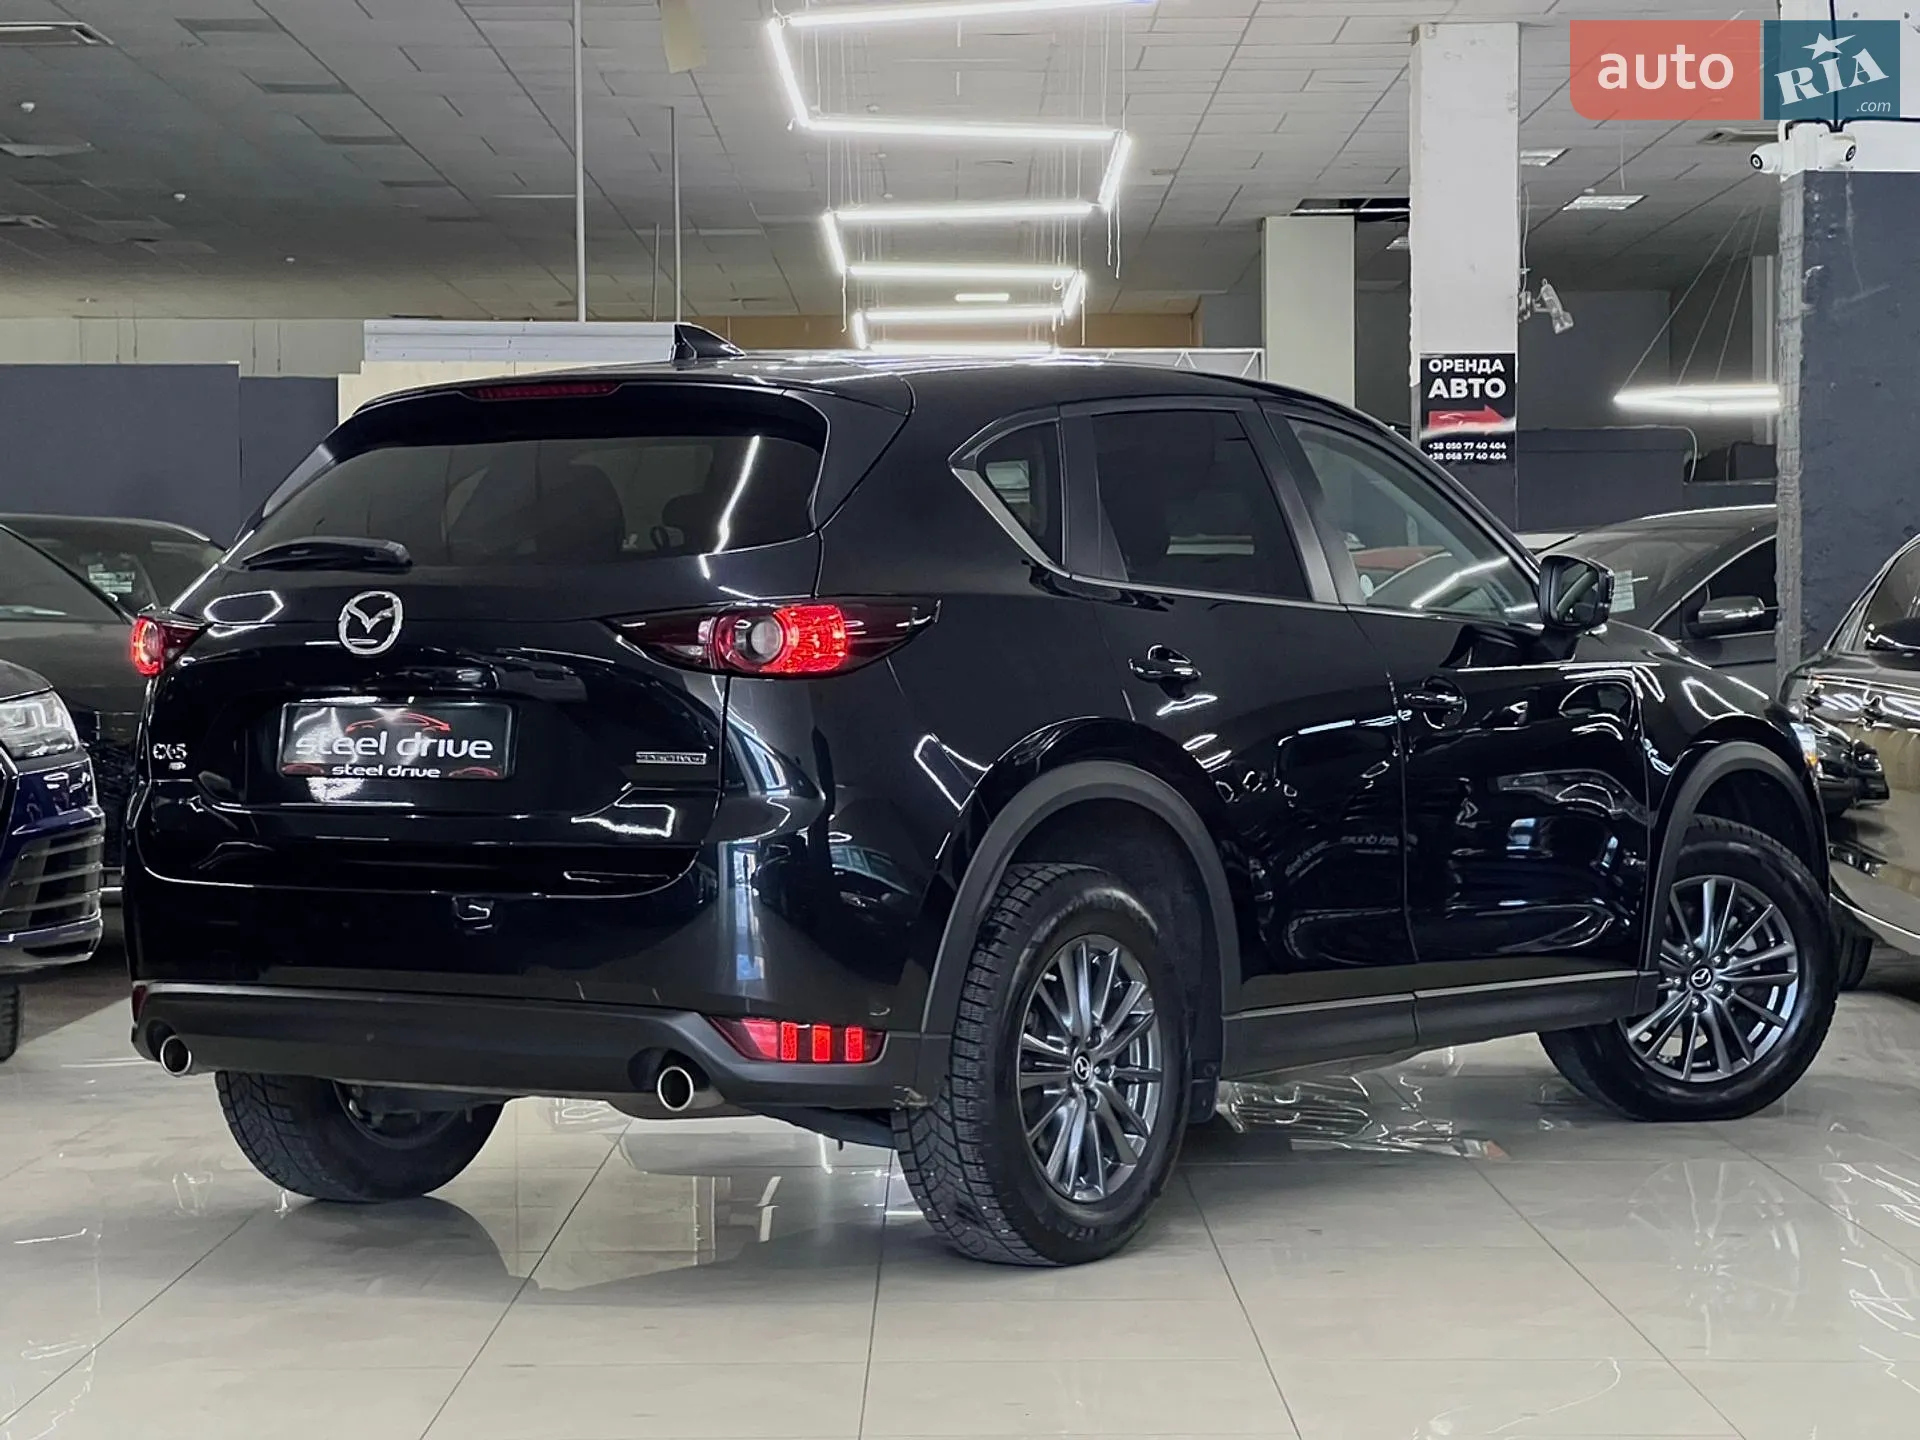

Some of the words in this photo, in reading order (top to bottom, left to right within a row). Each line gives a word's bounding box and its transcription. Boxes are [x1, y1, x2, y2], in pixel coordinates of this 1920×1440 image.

[1428, 358, 1506, 375] ОРЕНДА
[1427, 377, 1507, 399] АВТО
[1428, 442, 1444, 450] +38
[1463, 442, 1475, 450] 77
[1475, 442, 1488, 450] 40
[1489, 442, 1506, 450] 404
[1463, 452, 1475, 460] 77
[1475, 452, 1488, 460] 40
[1489, 452, 1506, 460] 404
[295, 730, 388, 757] steel
[396, 731, 494, 759] drive
[331, 763, 384, 777] steel
[387, 765, 441, 778] drive
